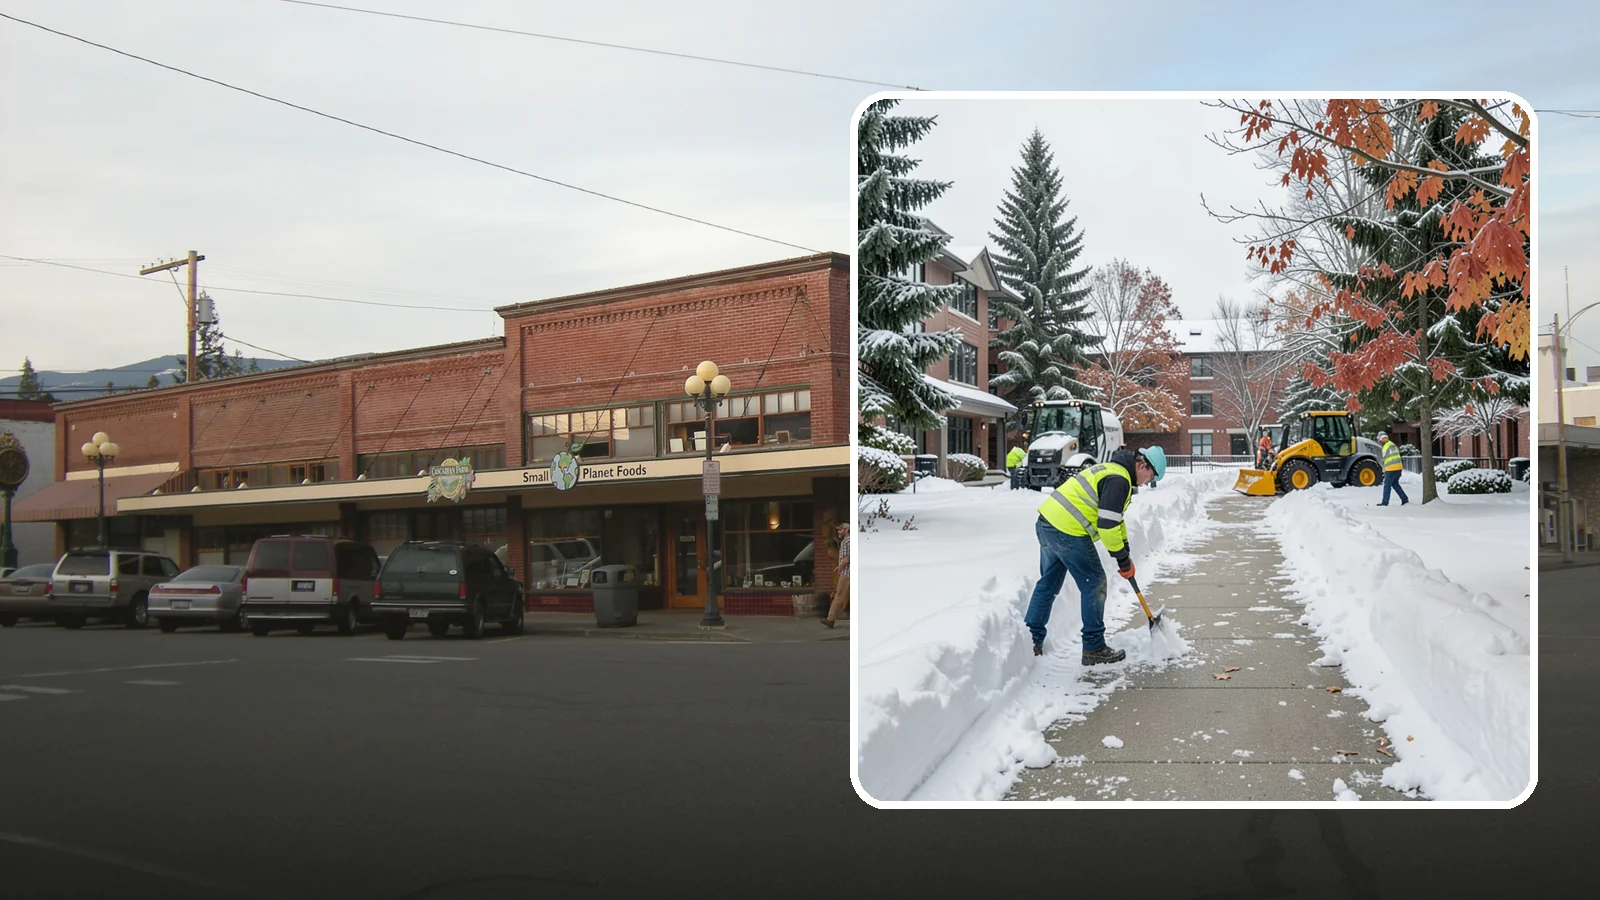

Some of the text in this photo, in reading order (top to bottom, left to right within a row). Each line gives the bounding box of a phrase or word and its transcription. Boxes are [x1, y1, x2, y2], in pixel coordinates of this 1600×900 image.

[523, 464, 647, 483] Small Planet Foods
